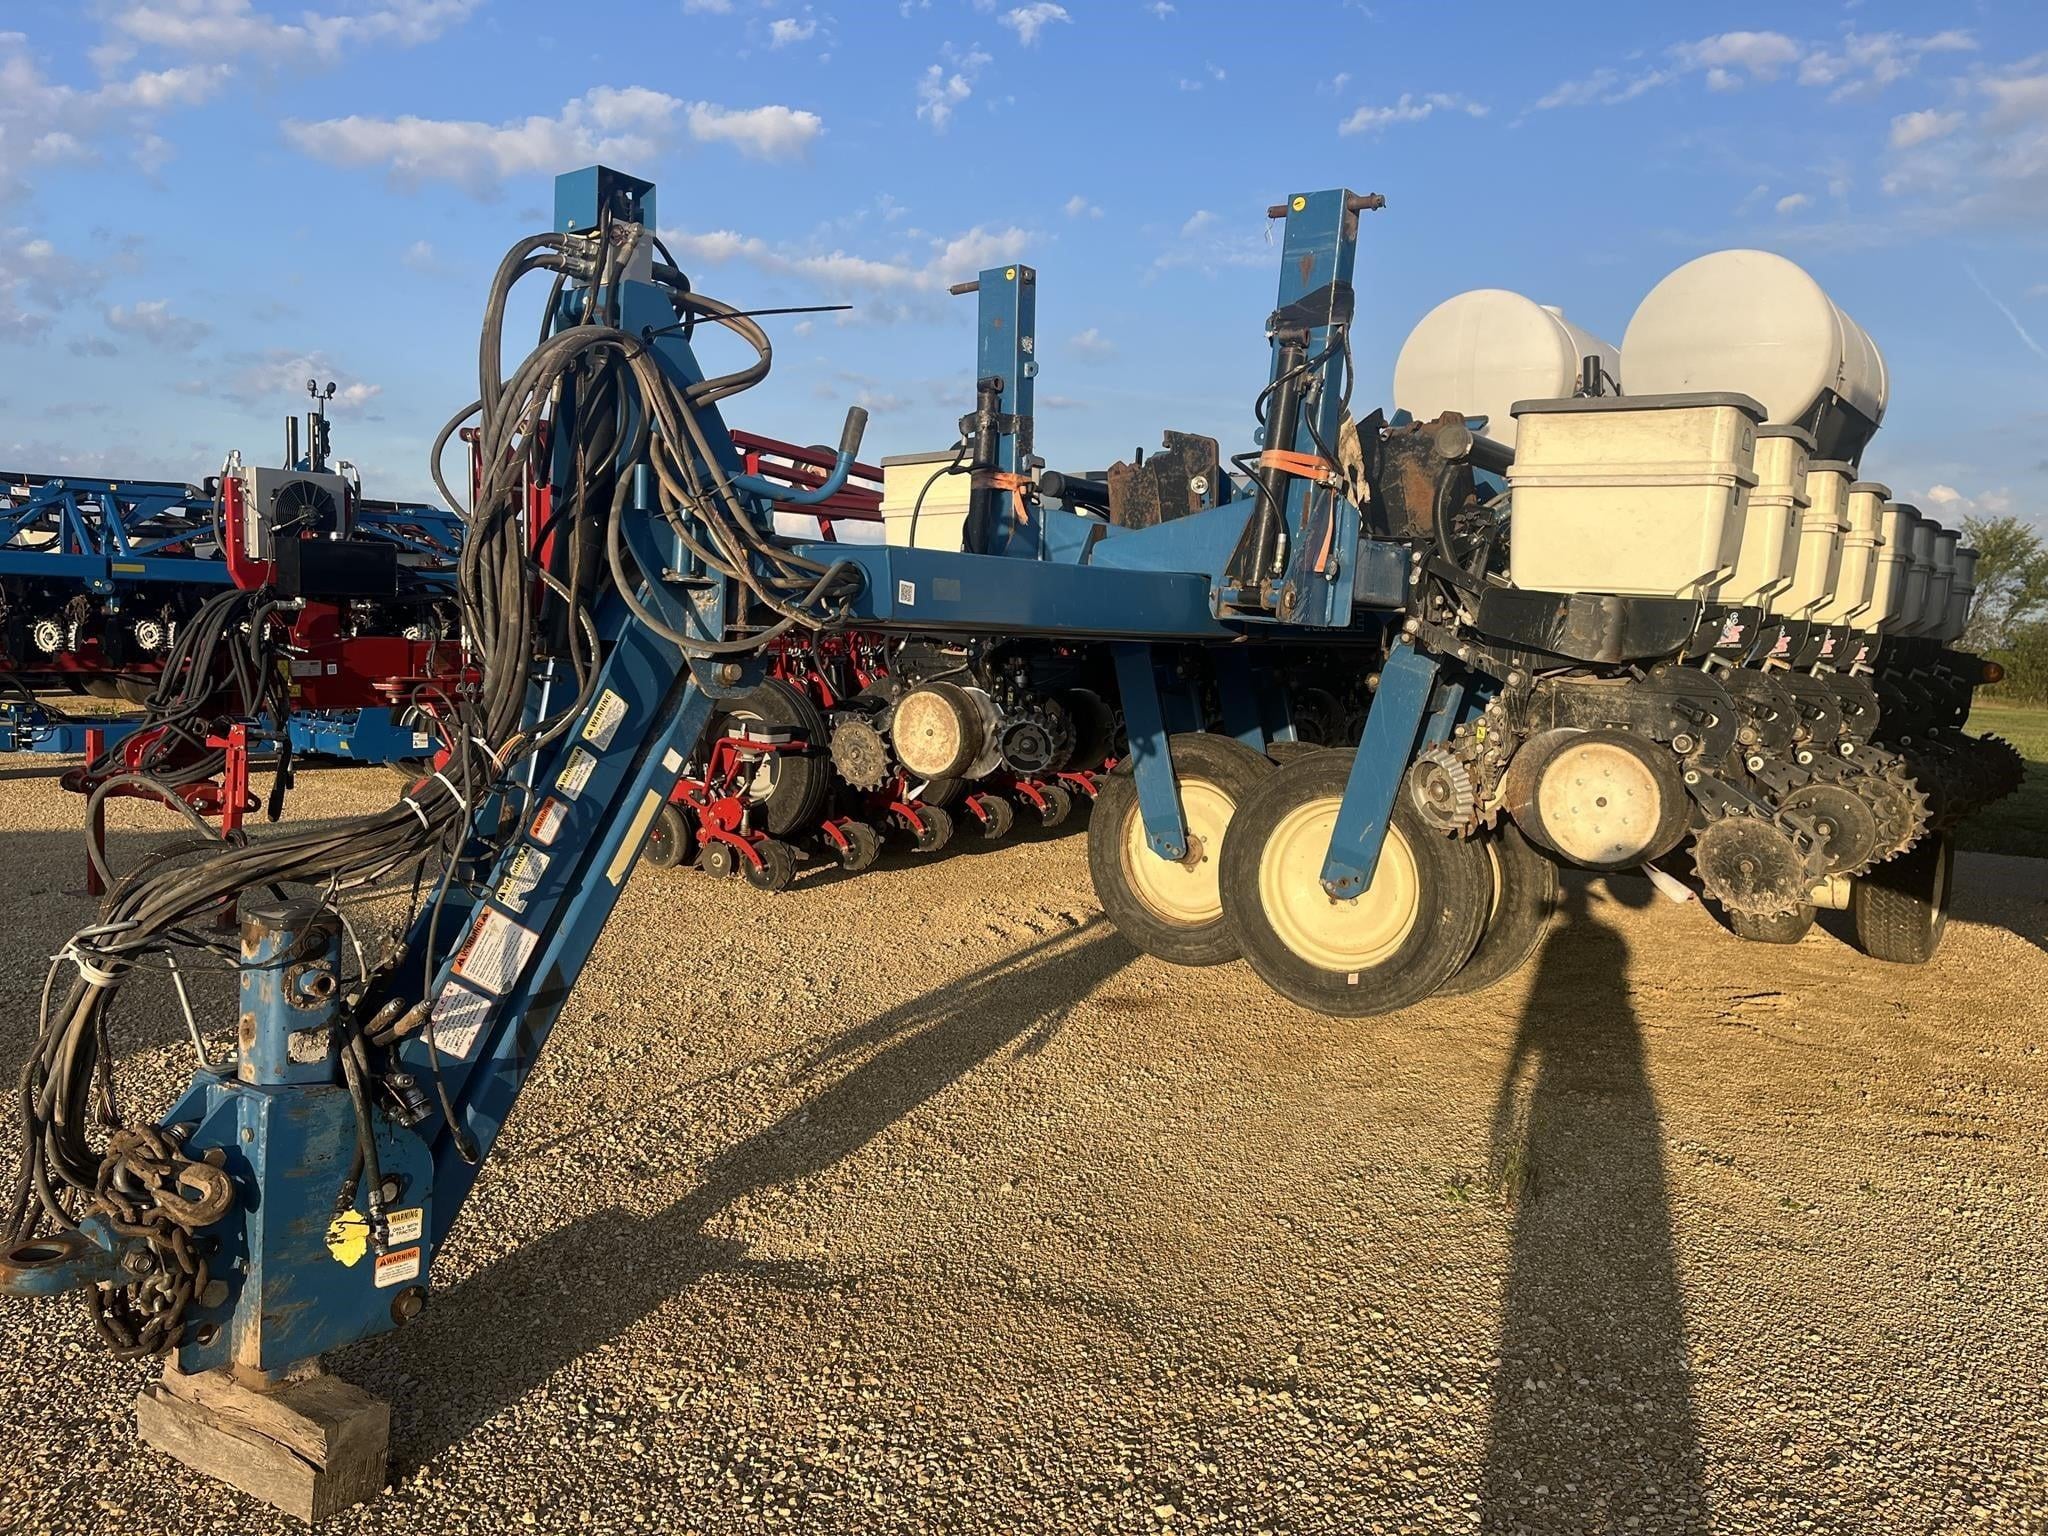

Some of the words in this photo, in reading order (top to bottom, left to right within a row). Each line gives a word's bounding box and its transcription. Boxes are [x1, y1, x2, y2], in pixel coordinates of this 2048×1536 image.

[591, 693, 612, 728] WARNING
[536, 799, 554, 827] WARNING
[502, 852, 526, 891] WANING
[391, 1209, 418, 1223] WARNING
[386, 1250, 417, 1264] WARNING
